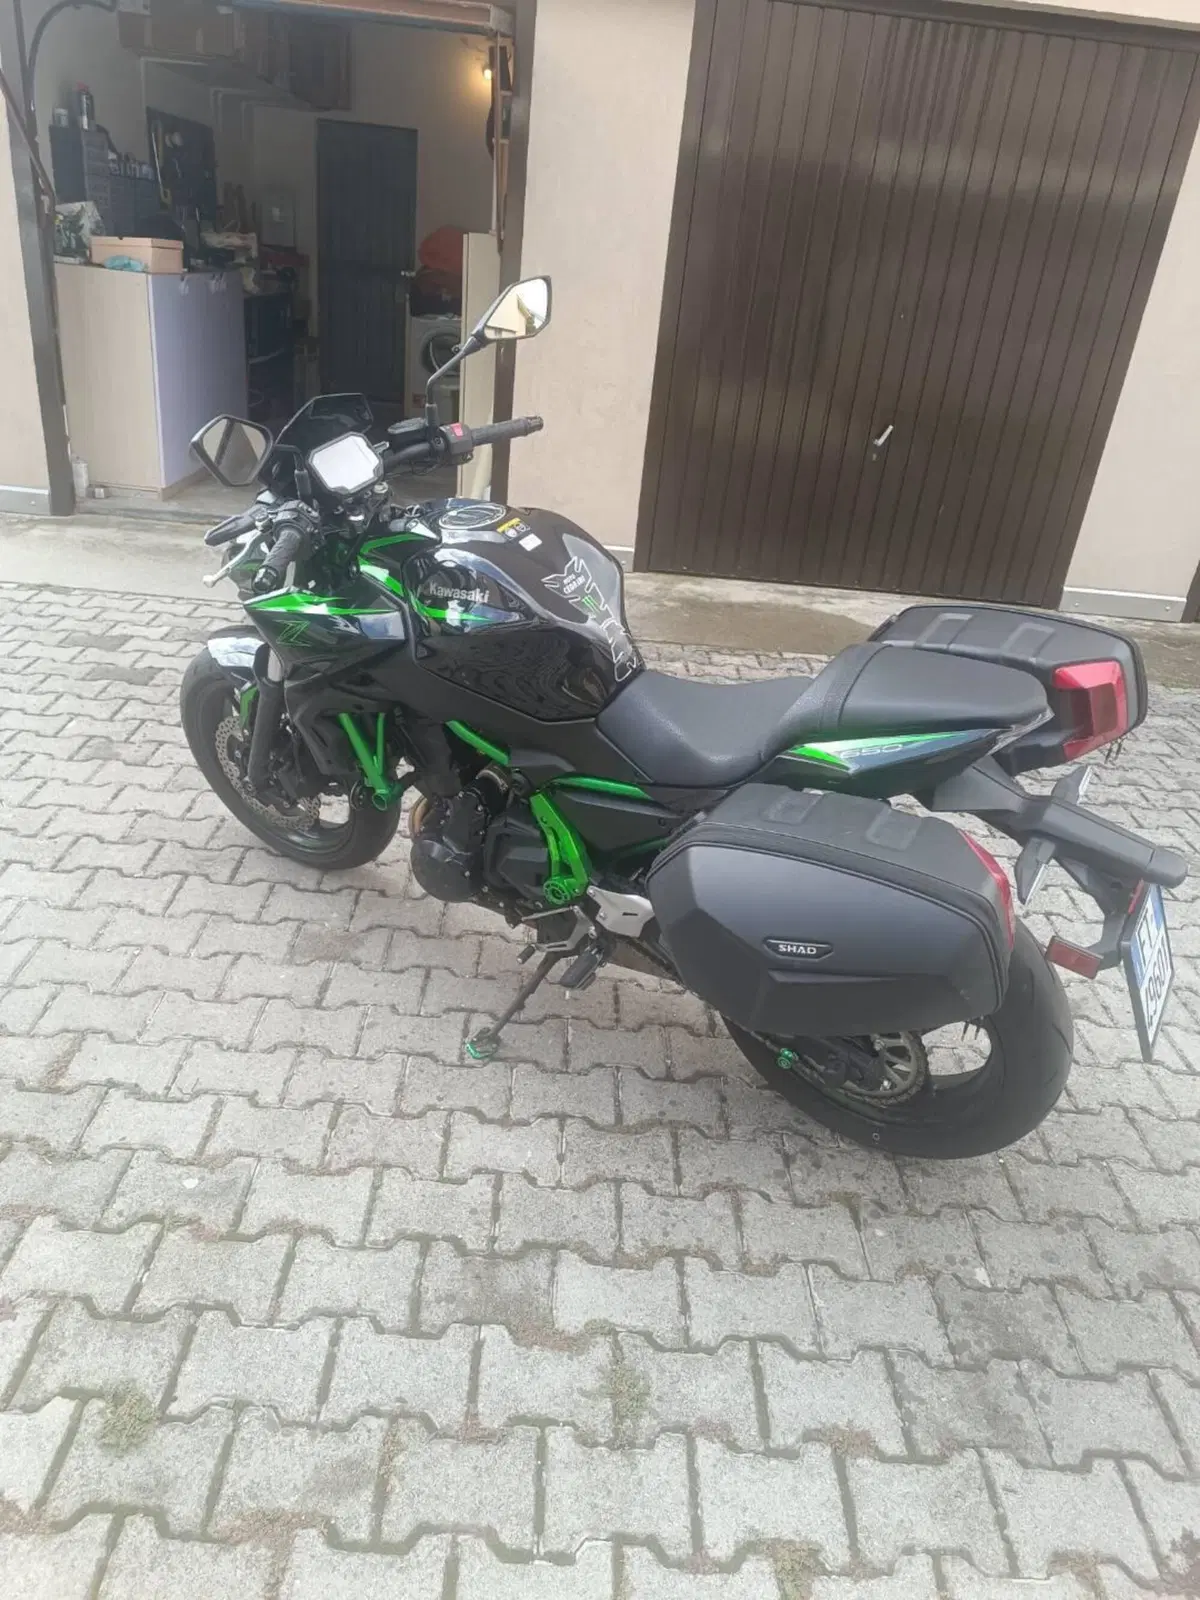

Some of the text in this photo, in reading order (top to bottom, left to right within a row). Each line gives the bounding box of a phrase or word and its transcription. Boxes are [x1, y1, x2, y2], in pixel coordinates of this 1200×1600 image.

[430, 580, 490, 603] Kawasaki
[840, 744, 903, 759] 650
[778, 944, 817, 955] SHAD
